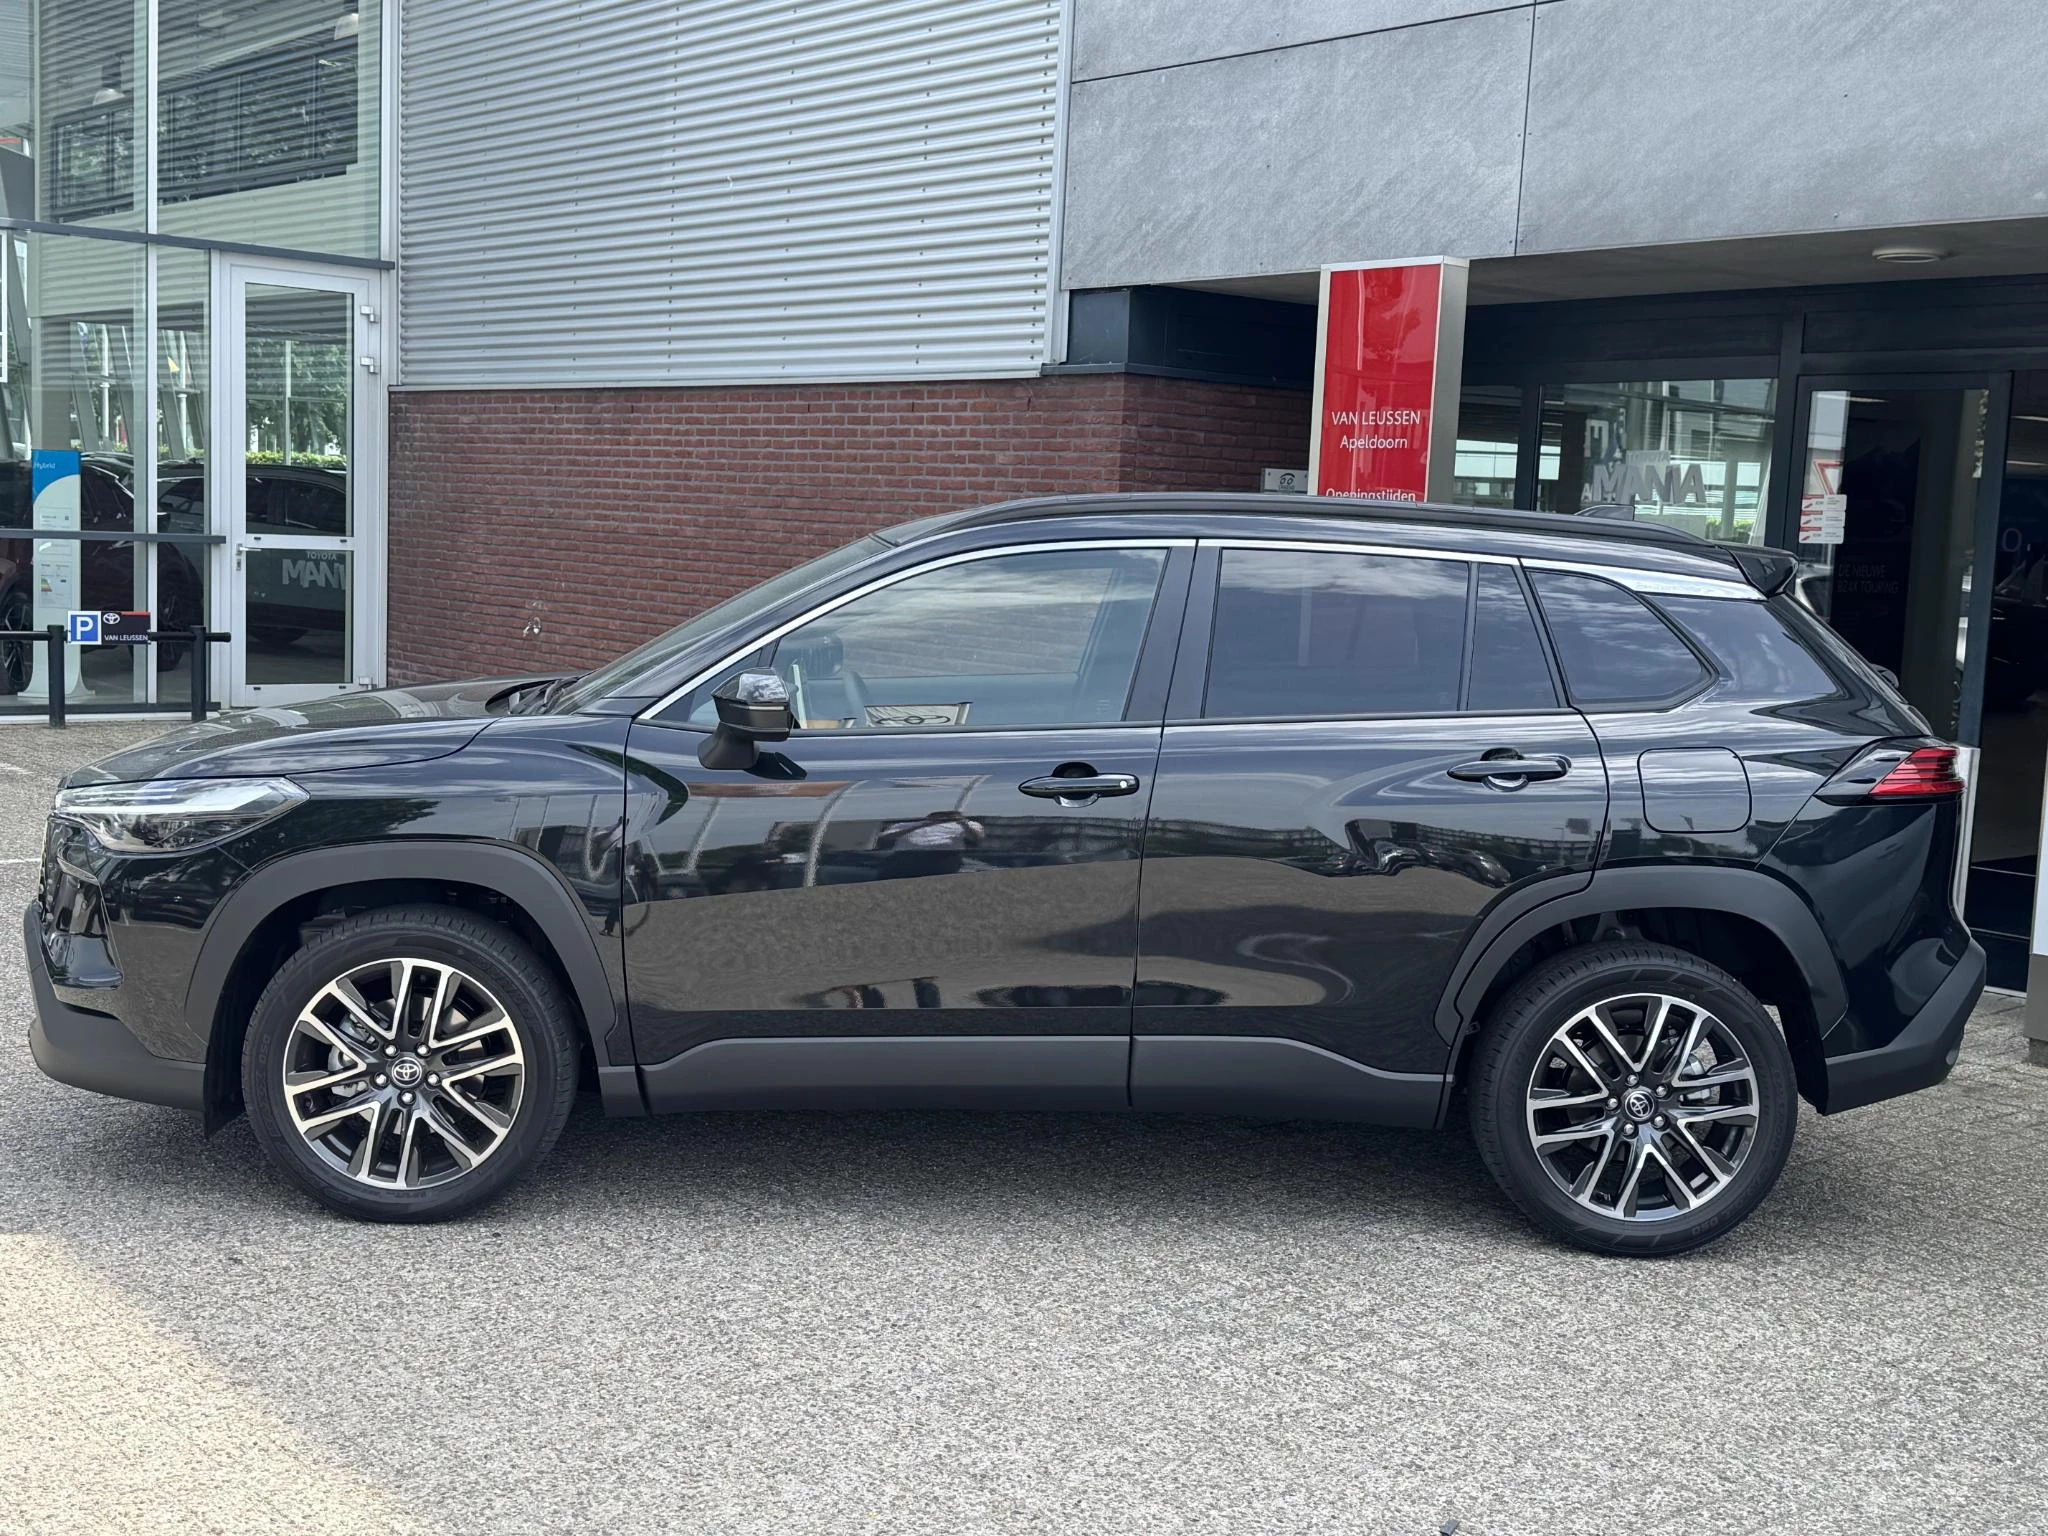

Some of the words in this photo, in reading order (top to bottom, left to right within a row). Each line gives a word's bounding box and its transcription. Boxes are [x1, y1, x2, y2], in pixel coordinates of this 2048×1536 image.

[1331, 411, 1358, 425] VAN
[1361, 410, 1421, 425] LEUSSEN
[1339, 434, 1408, 453] Apeldoorn
[1592, 463, 1707, 504] MANIA
[305, 551, 337, 560] TOYOTA
[76, 616, 94, 640] P
